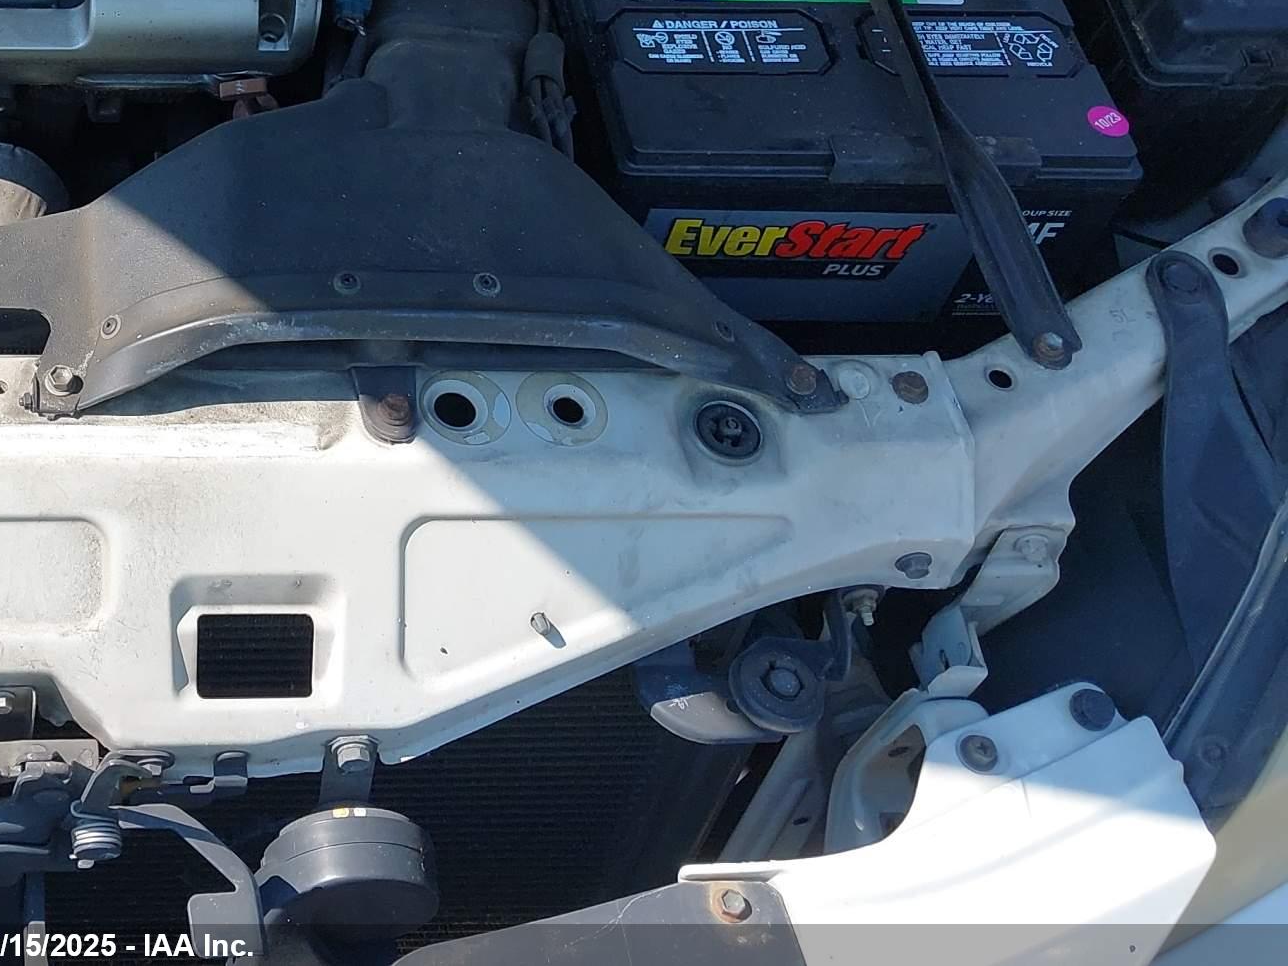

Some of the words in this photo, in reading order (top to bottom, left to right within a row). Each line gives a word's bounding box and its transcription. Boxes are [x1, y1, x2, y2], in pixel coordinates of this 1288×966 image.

[665, 20, 718, 28] DANGER
[730, 20, 779, 28] POISON
[1095, 112, 1121, 129] 10/23
[665, 218, 927, 260] EverStart
[822, 264, 884, 276] PLUS
